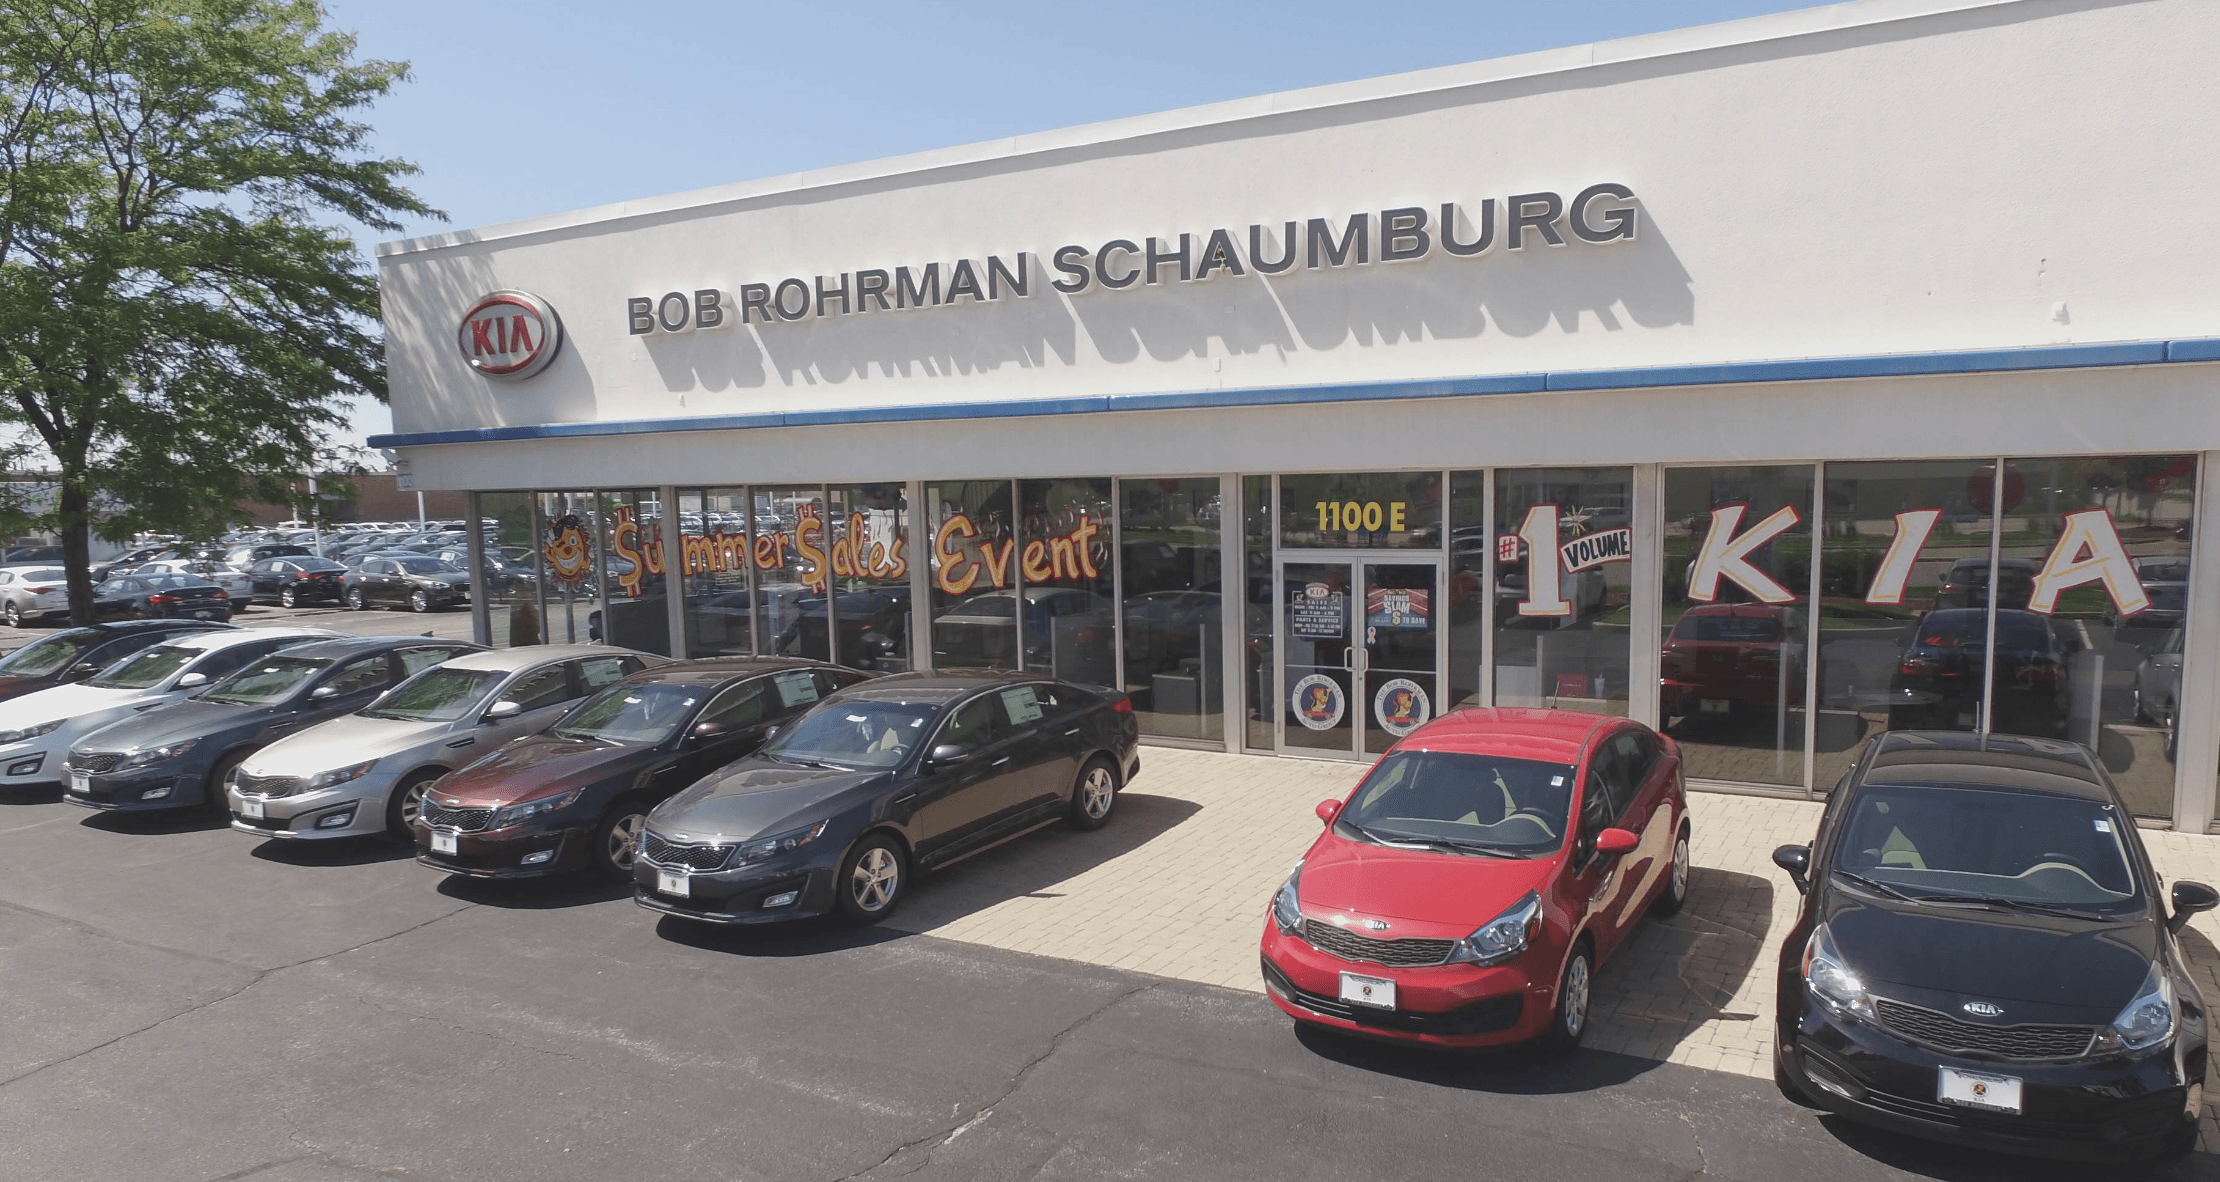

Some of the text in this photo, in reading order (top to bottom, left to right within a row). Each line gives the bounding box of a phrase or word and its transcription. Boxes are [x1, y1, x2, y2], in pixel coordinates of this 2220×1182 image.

[627, 182, 1639, 336] BOB ROHRMAN SCHAUMBURG
[469, 314, 534, 357] KIA
[1315, 501, 1406, 532] 1100 E
[935, 513, 1098, 596] Event
[1564, 530, 1630, 568] VOLUME
[1309, 588, 1326, 597] KIA
[1971, 1003, 1997, 1014] KIA
